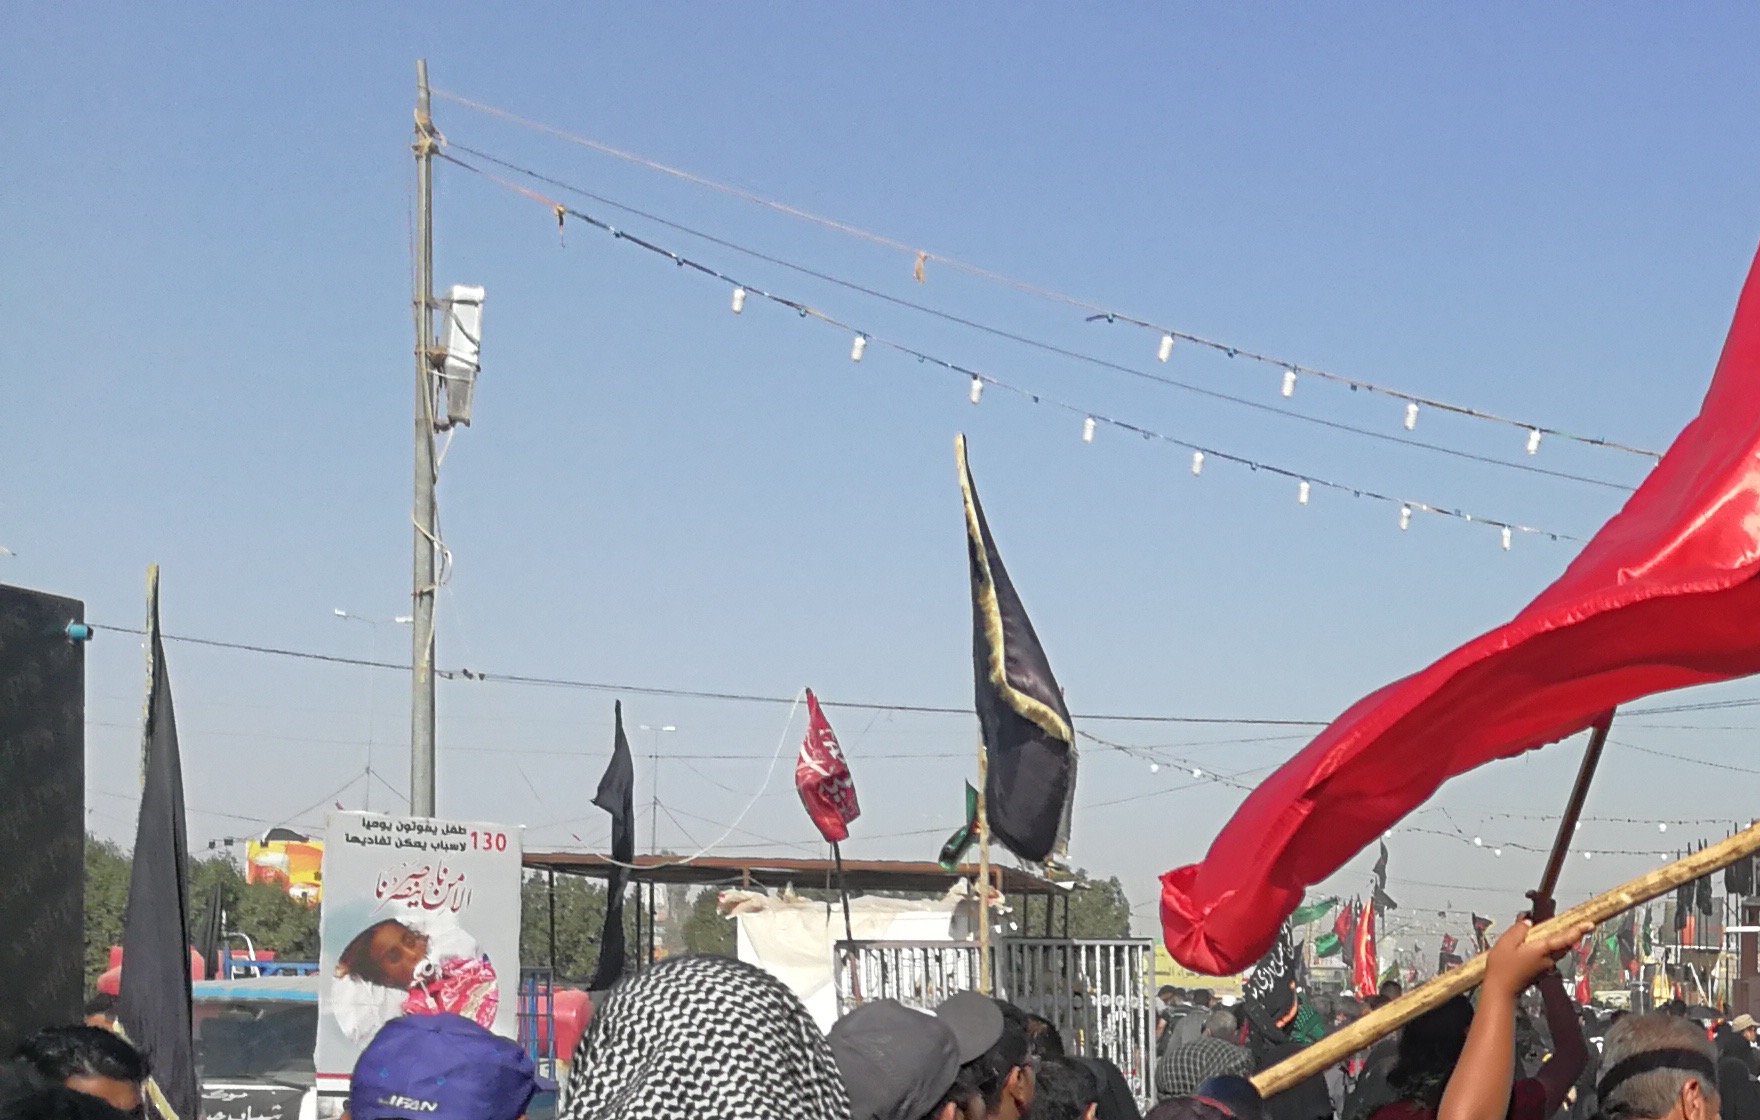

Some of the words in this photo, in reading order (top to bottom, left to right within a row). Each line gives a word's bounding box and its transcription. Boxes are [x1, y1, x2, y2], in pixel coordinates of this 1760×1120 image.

[362, 817, 393, 832] يوميا
[441, 823, 467, 836] طفل
[344, 832, 392, 847] تفاديها
[394, 837, 428, 852] يمكن
[431, 840, 467, 852] لاسباب
[470, 831, 508, 852] 130
